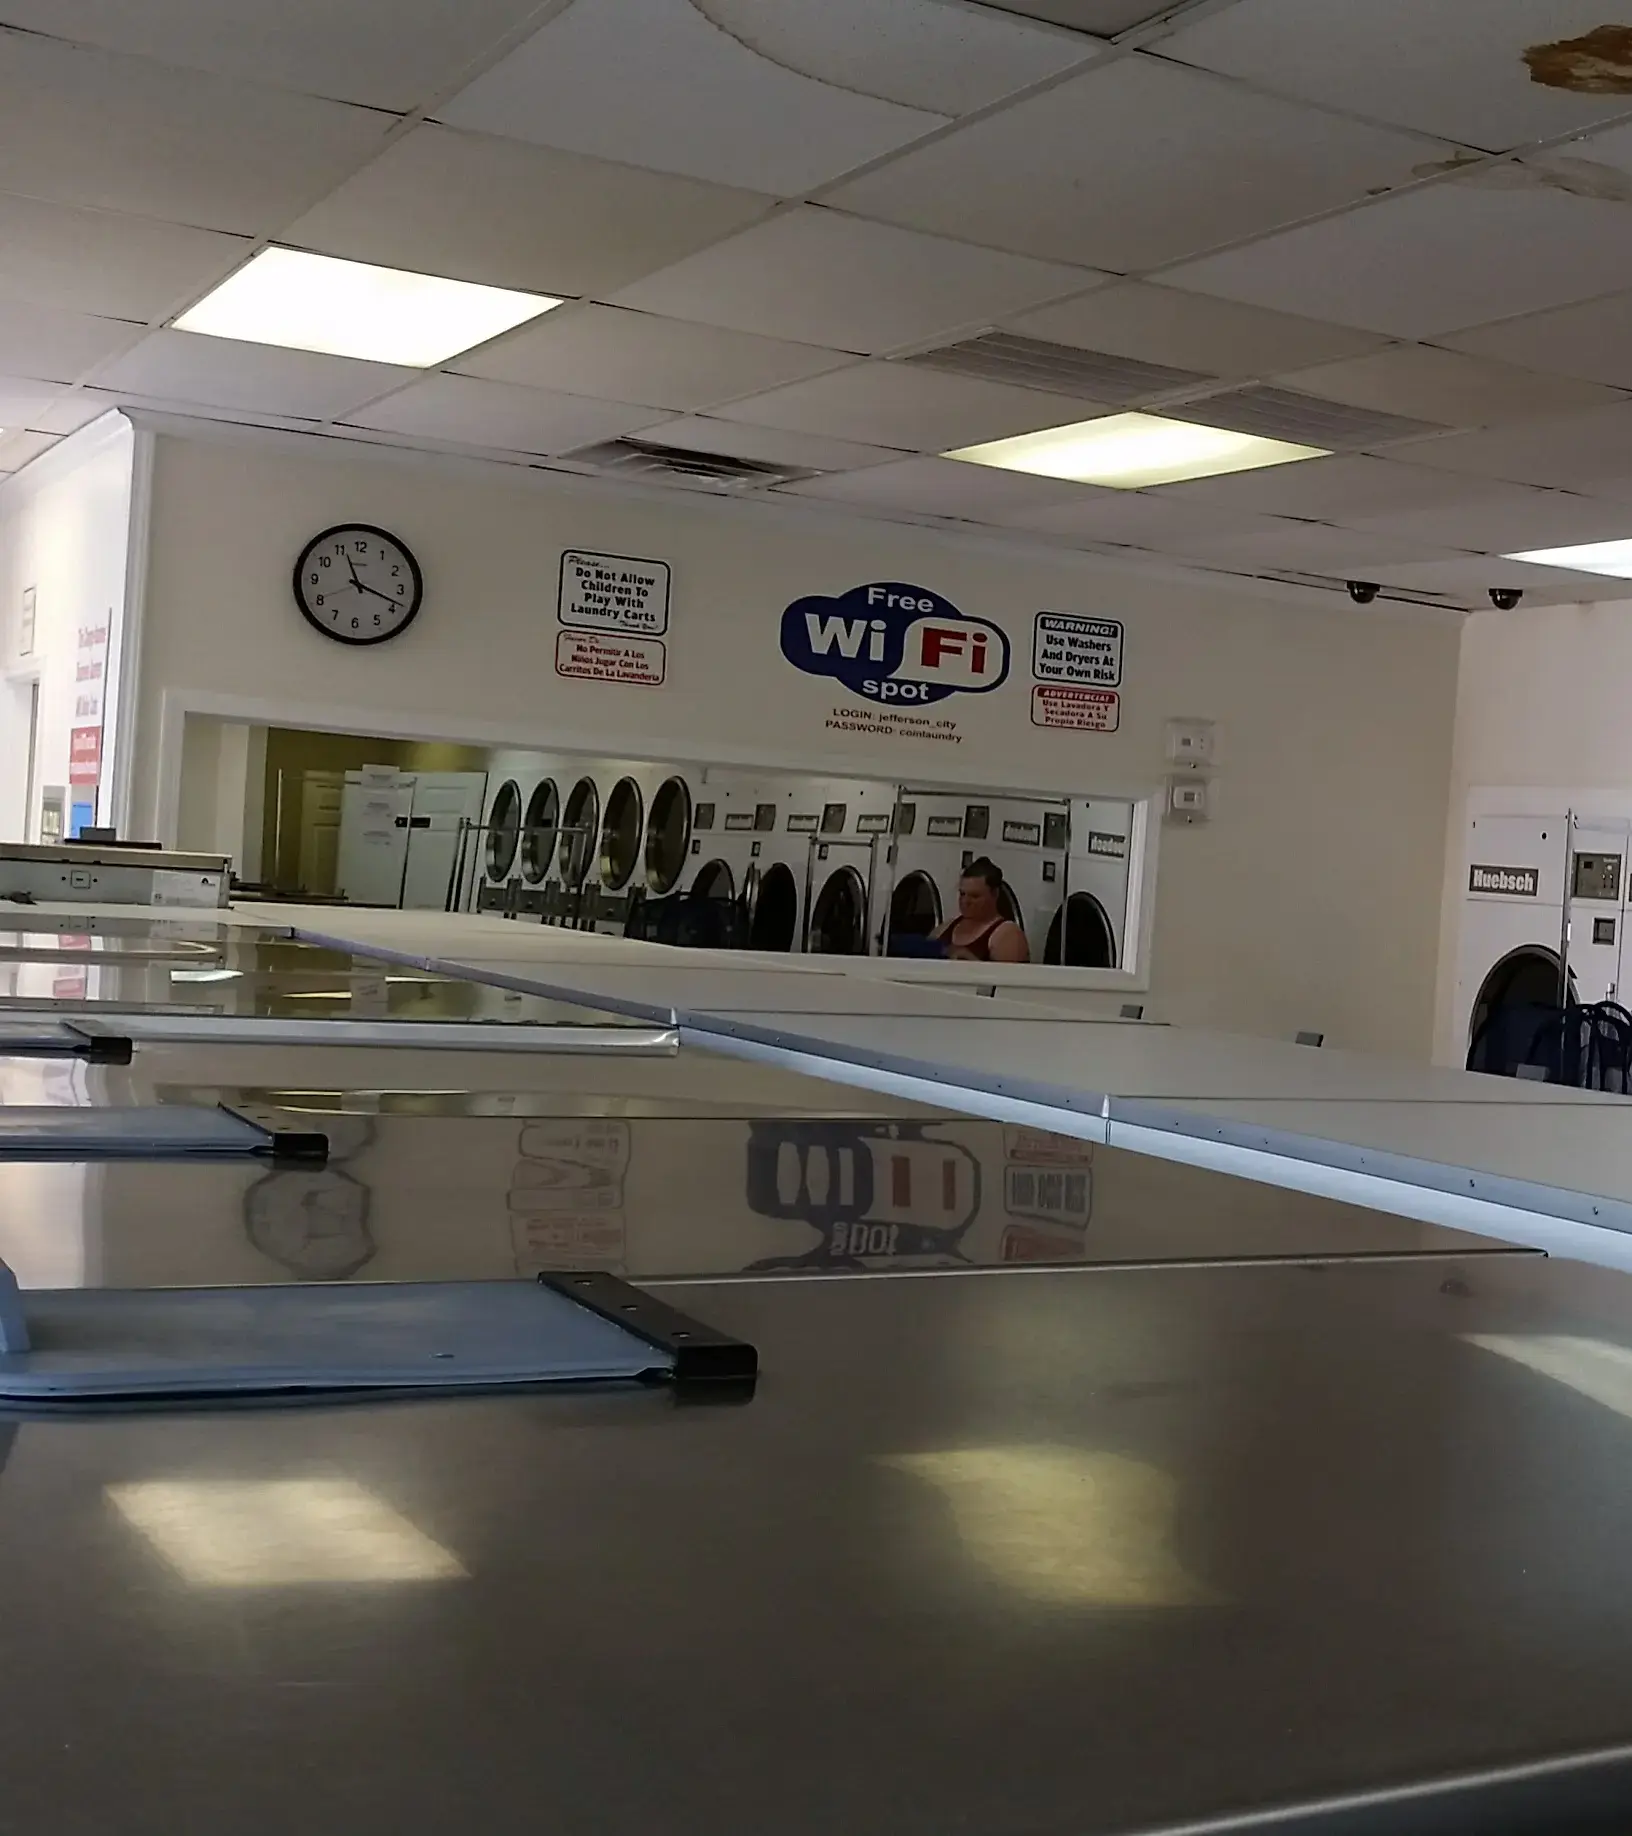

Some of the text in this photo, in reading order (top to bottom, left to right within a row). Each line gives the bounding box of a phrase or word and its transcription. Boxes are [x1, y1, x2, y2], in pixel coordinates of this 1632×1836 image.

[335, 544, 345, 555] 11
[354, 541, 367, 553] 12
[318, 556, 331, 568] 10
[379, 550, 385, 561] 1
[391, 565, 399, 577] 2
[575, 567, 656, 586] Do Not Allow
[310, 573, 319, 585] 9
[396, 584, 405, 595] 3
[581, 580, 649, 597] Children To
[316, 594, 325, 606] 8
[584, 593, 645, 609] Play With
[867, 586, 934, 613] Free
[331, 609, 339, 621] 7
[388, 602, 396, 614] 4
[571, 603, 656, 622] Laundry Carts
[351, 617, 359, 629] 6
[373, 614, 381, 626] 5
[1044, 619, 1115, 636] WARNING!
[804, 612, 989, 675] Wi Fi
[1045, 634, 1112, 652] Use Washers
[576, 643, 645, 659] No Permitir A Los
[1041, 649, 1114, 666] And Dryers At
[559, 663, 592, 675] Carritos
[593, 667, 604, 676] De
[605, 668, 616, 677] La
[594, 656, 617, 668] Jugar
[619, 659, 634, 669] Con
[635, 661, 649, 671] Los
[1039, 662, 1115, 681] Your Own Risk
[862, 679, 930, 700] spot
[1042, 699, 1058, 708] Use
[1060, 700, 1101, 711] Lavadora
[879, 712, 957, 730] jefferson_city
[1044, 707, 1108, 720] Secadora A Su
[1045, 715, 1106, 730] Propio Riesgo
[1472, 868, 1535, 892] Huebsch
